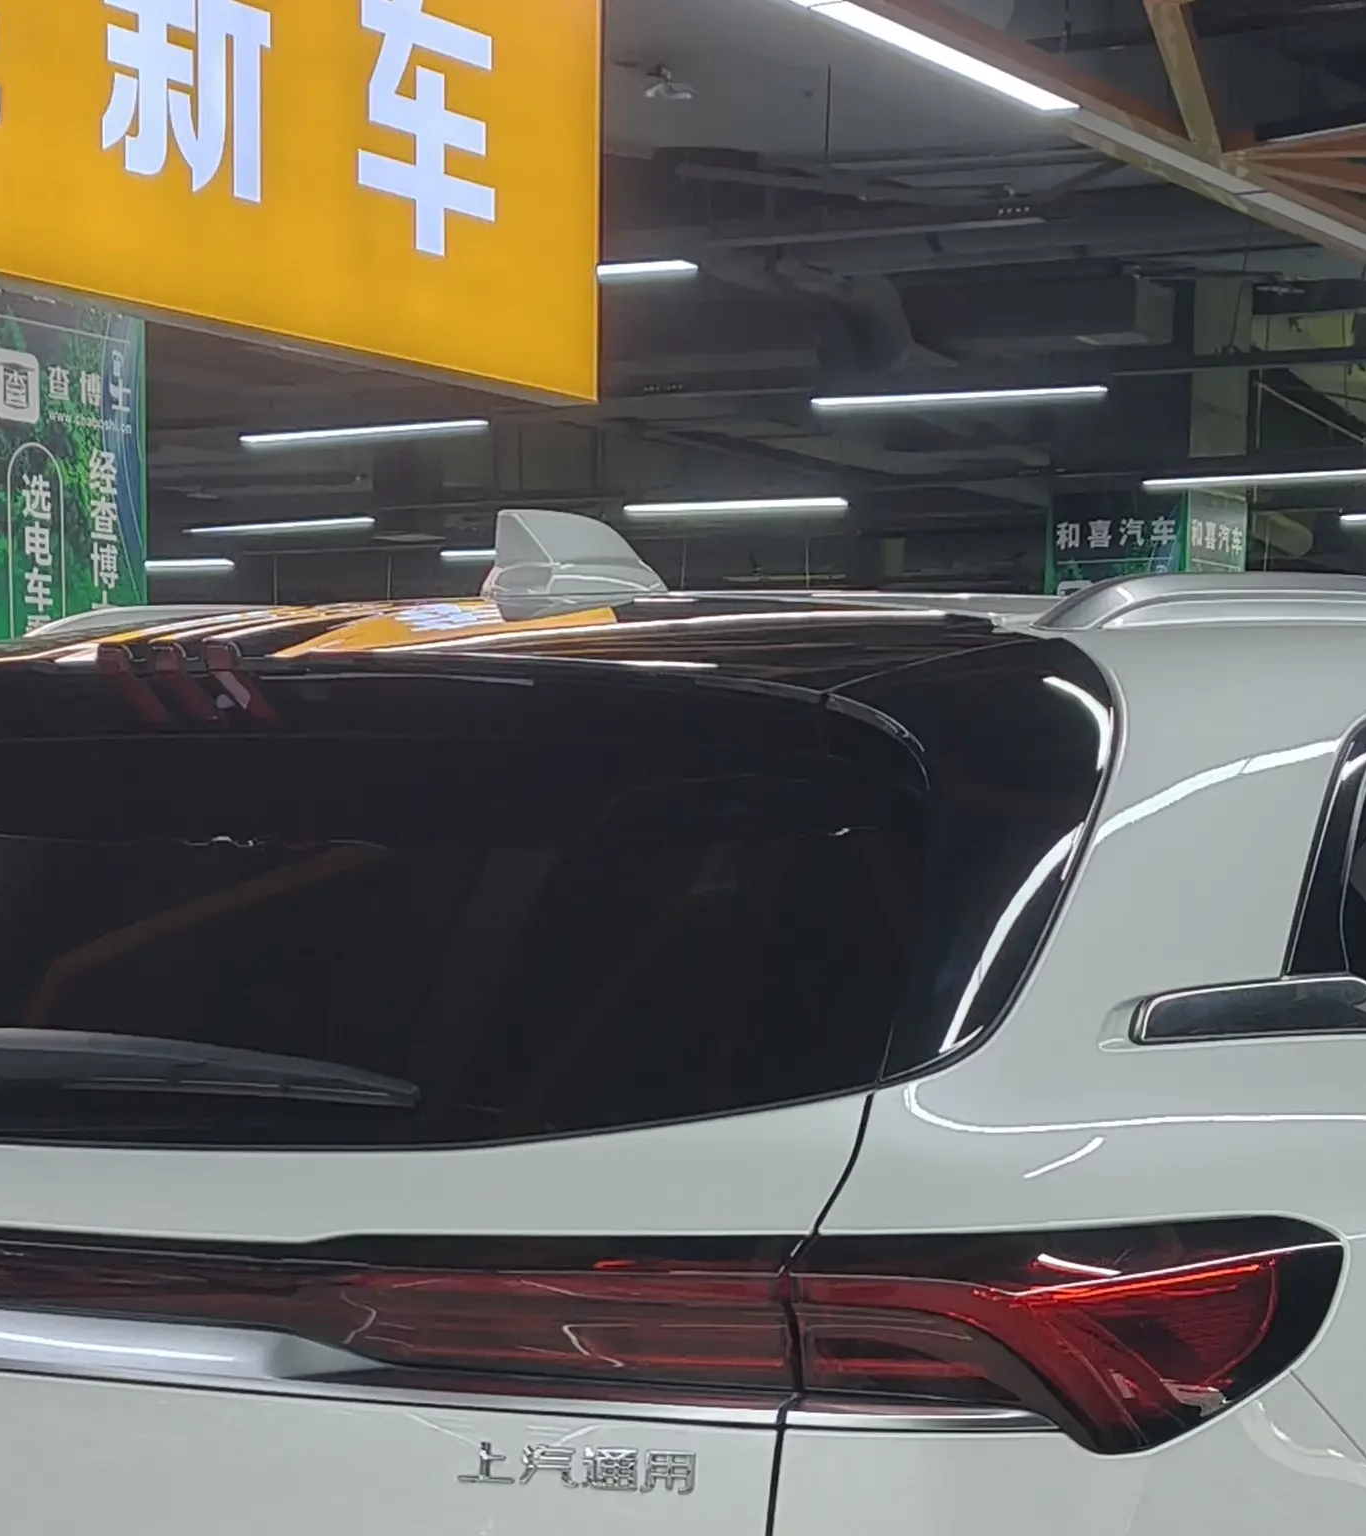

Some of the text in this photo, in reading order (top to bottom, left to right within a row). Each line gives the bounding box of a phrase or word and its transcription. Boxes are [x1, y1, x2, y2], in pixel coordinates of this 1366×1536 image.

[47, 365, 132, 414] 查博士
[47, 407, 133, 435] www.chaboshi.cn
[21, 473, 54, 632] 选电车
[1055, 516, 1178, 552] 和喜汽车
[1190, 518, 1244, 556] 和喜汽车
[456, 1440, 698, 1496] 上汽通用
